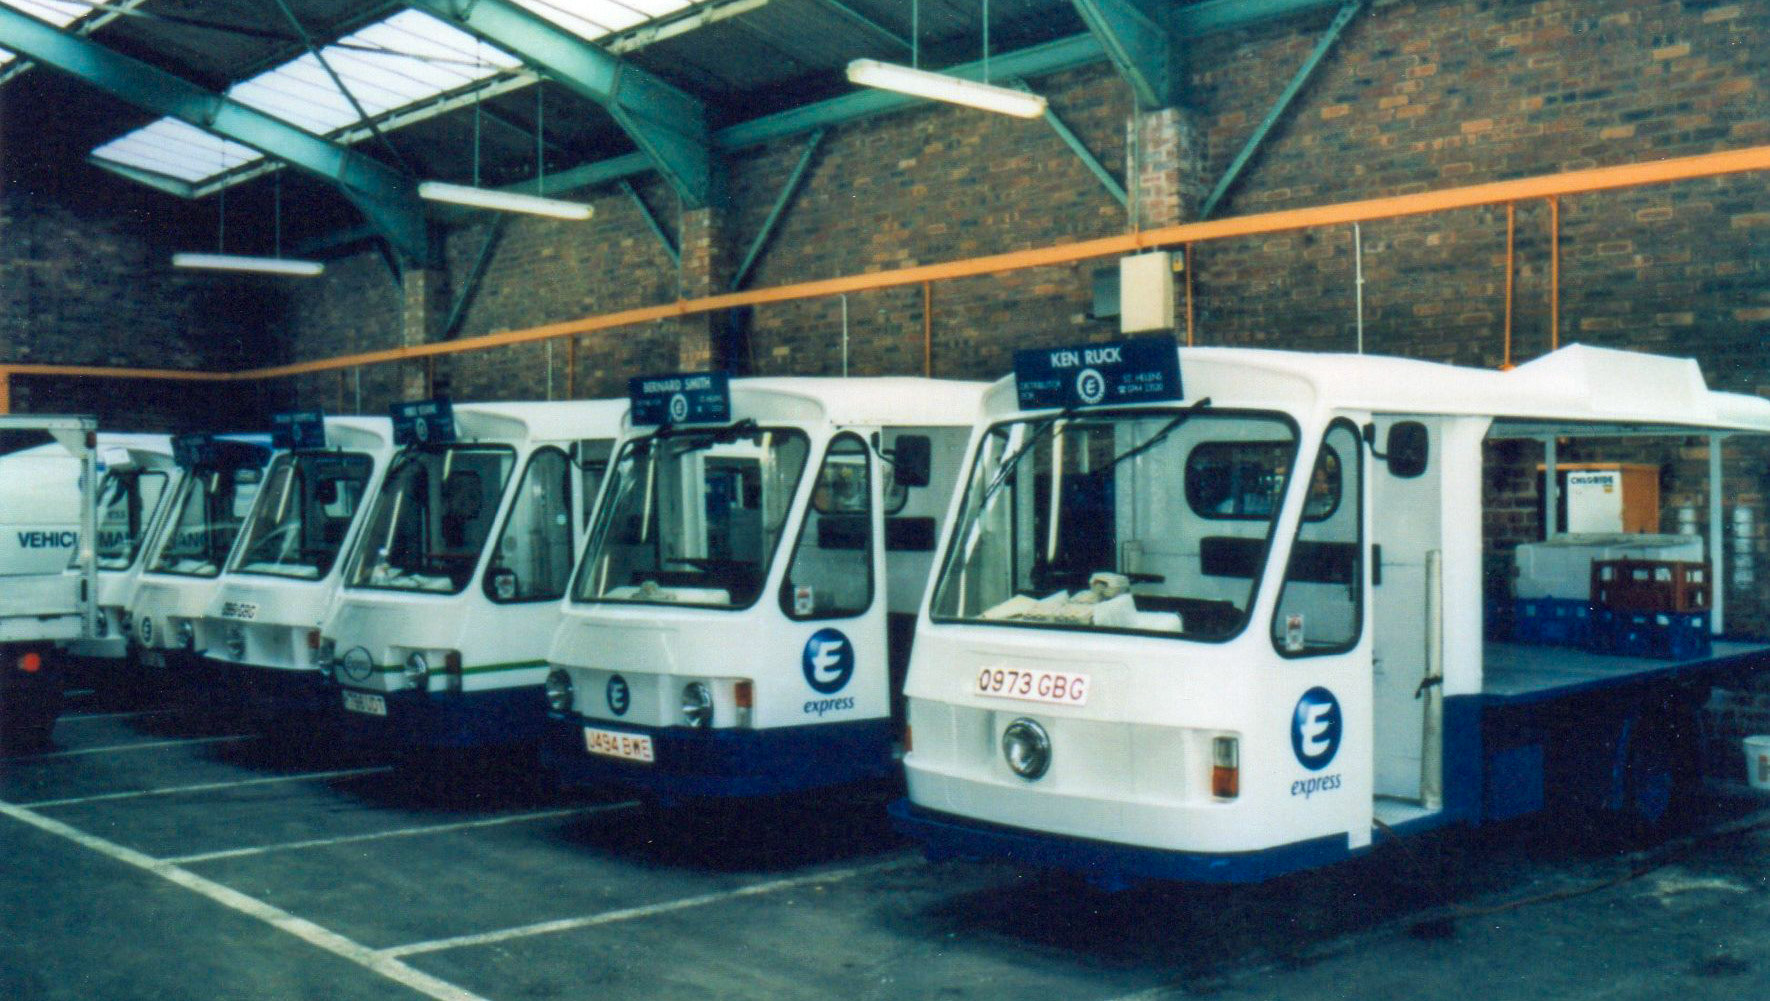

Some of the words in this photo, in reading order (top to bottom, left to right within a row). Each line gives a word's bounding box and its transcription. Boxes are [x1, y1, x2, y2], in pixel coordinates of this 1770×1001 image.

[1050, 350, 1080, 368] KEN
[1084, 347, 1122, 365] RUCK
[979, 668, 1033, 695] 0973
[1037, 674, 1085, 700] GBG
[803, 696, 855, 717] express
[1290, 773, 1342, 799] express
